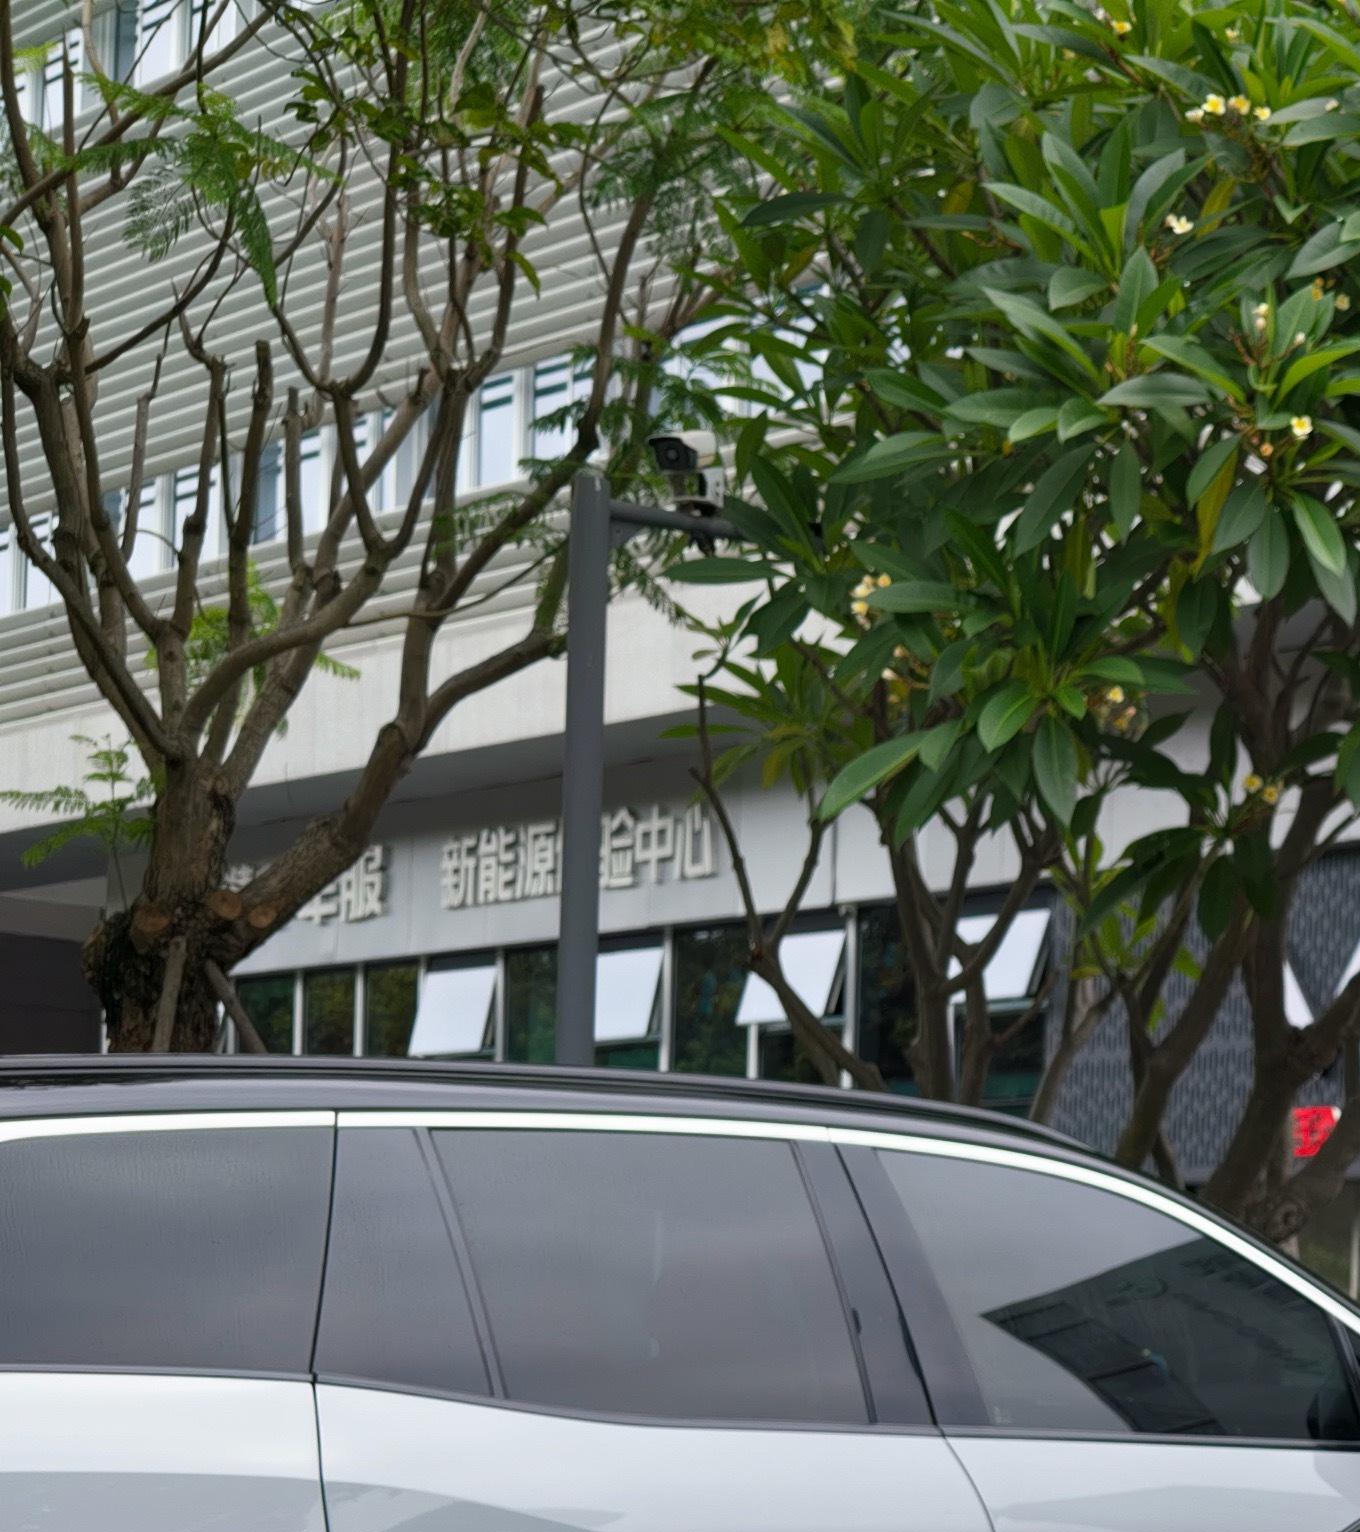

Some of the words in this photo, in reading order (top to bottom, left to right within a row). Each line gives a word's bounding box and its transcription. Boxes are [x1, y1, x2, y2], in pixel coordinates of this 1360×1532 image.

[441, 806, 714, 909] 新能源验中心
